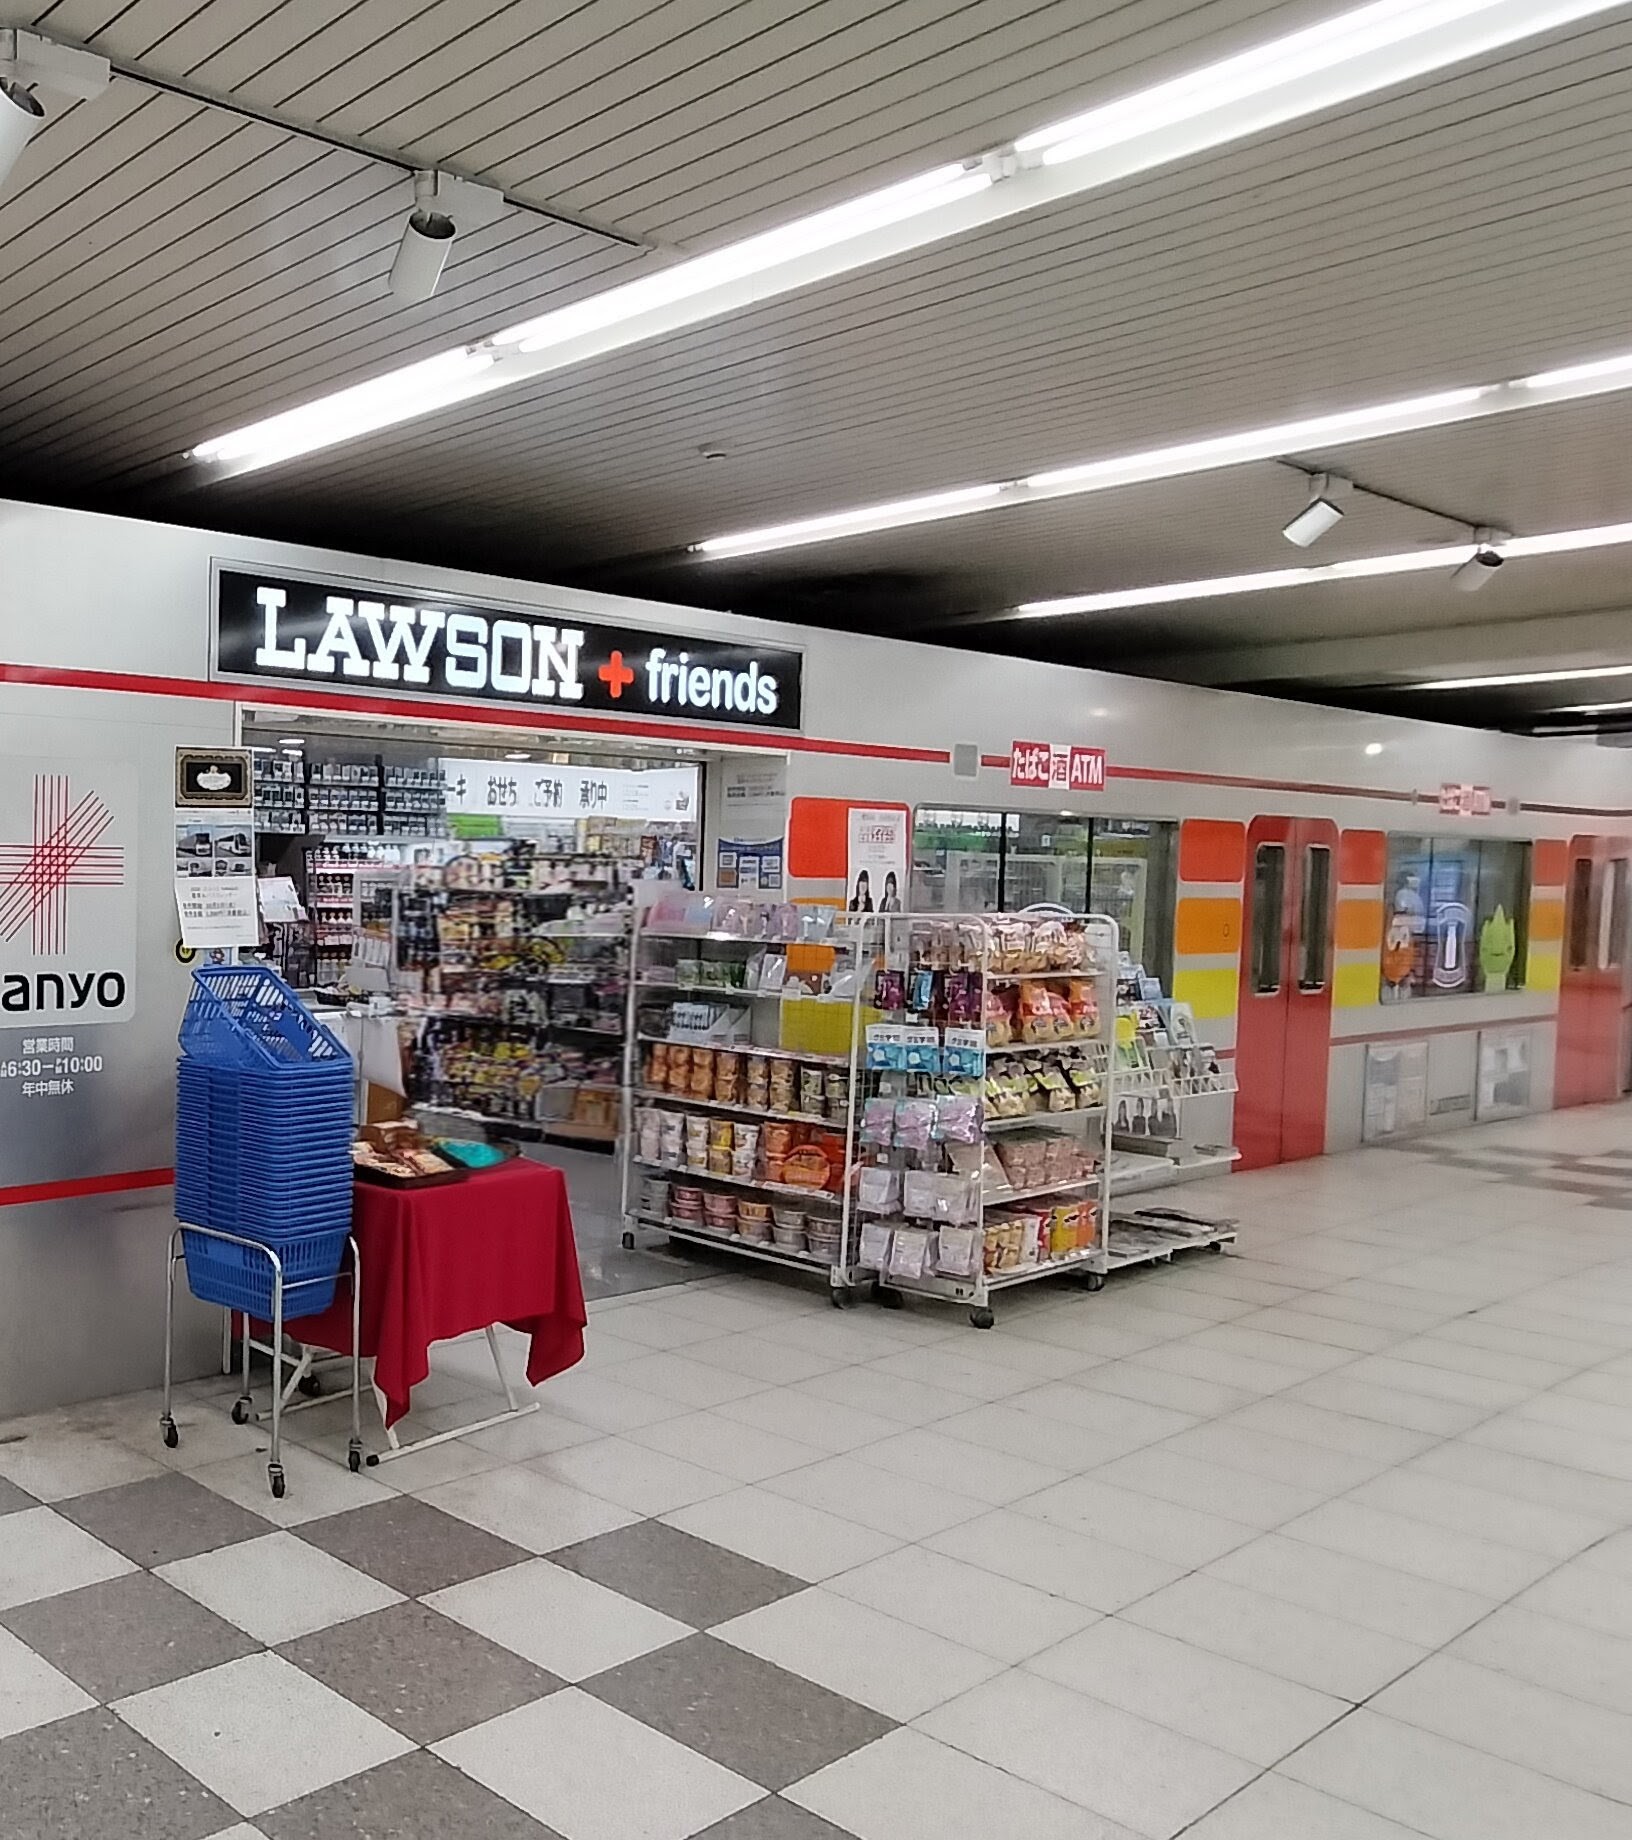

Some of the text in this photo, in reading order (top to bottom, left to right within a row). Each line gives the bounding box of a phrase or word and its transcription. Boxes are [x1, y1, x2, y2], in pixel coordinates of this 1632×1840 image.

[256, 586, 585, 700] LAWSON
[645, 647, 779, 715] friends
[1012, 747, 1103, 785] たばこ 酒 ATM
[487, 775, 518, 807] おせち
[22, 1036, 74, 1055] 営業時間
[22, 1079, 75, 1097] 年中無休
